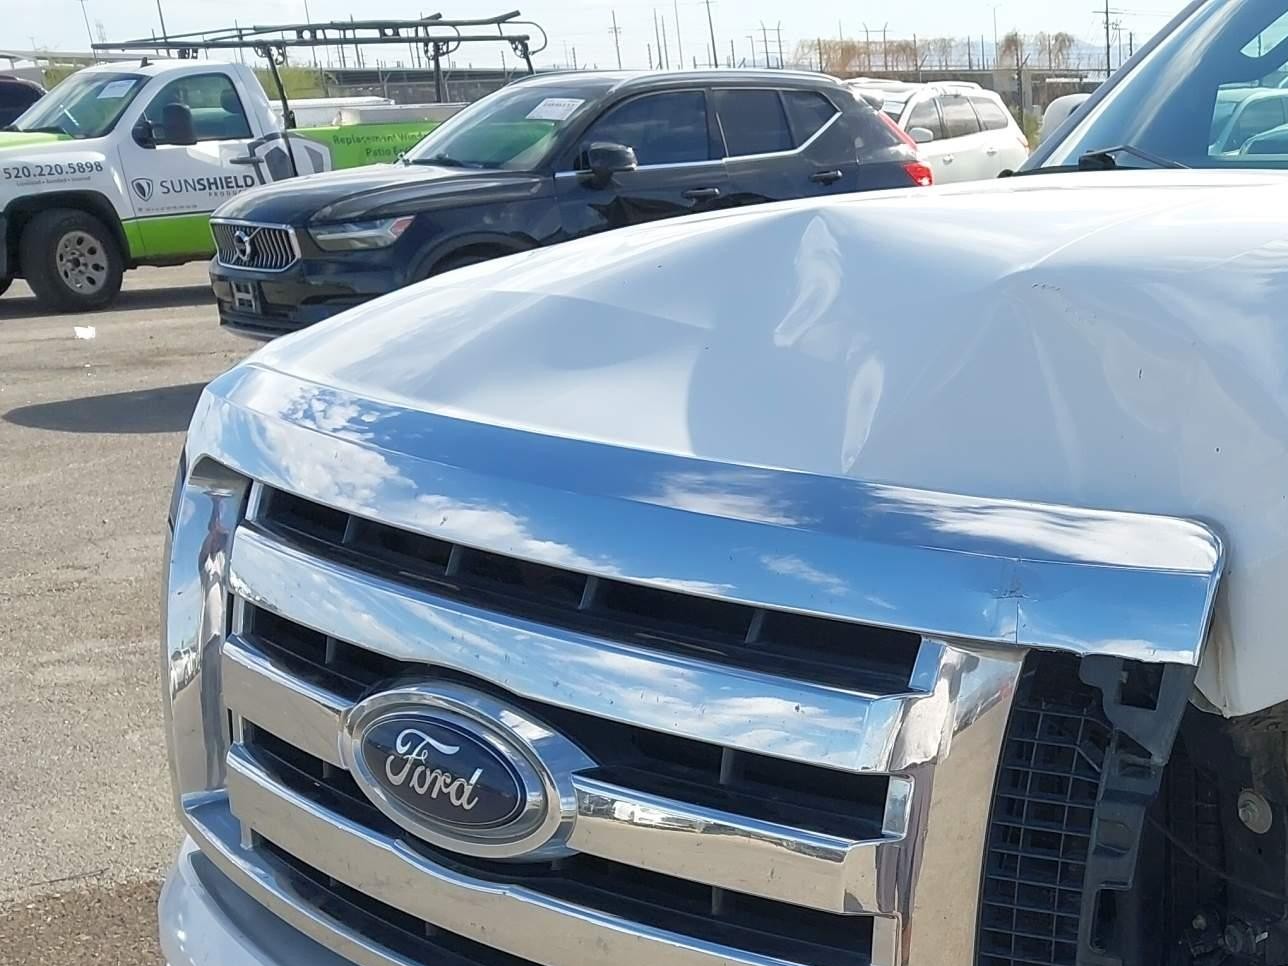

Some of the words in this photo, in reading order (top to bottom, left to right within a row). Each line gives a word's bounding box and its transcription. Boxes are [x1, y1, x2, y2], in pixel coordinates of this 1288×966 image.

[3, 161, 103, 179] 520.220.5898
[160, 174, 255, 194] SUNSHIELD
[386, 728, 483, 810] Ford
